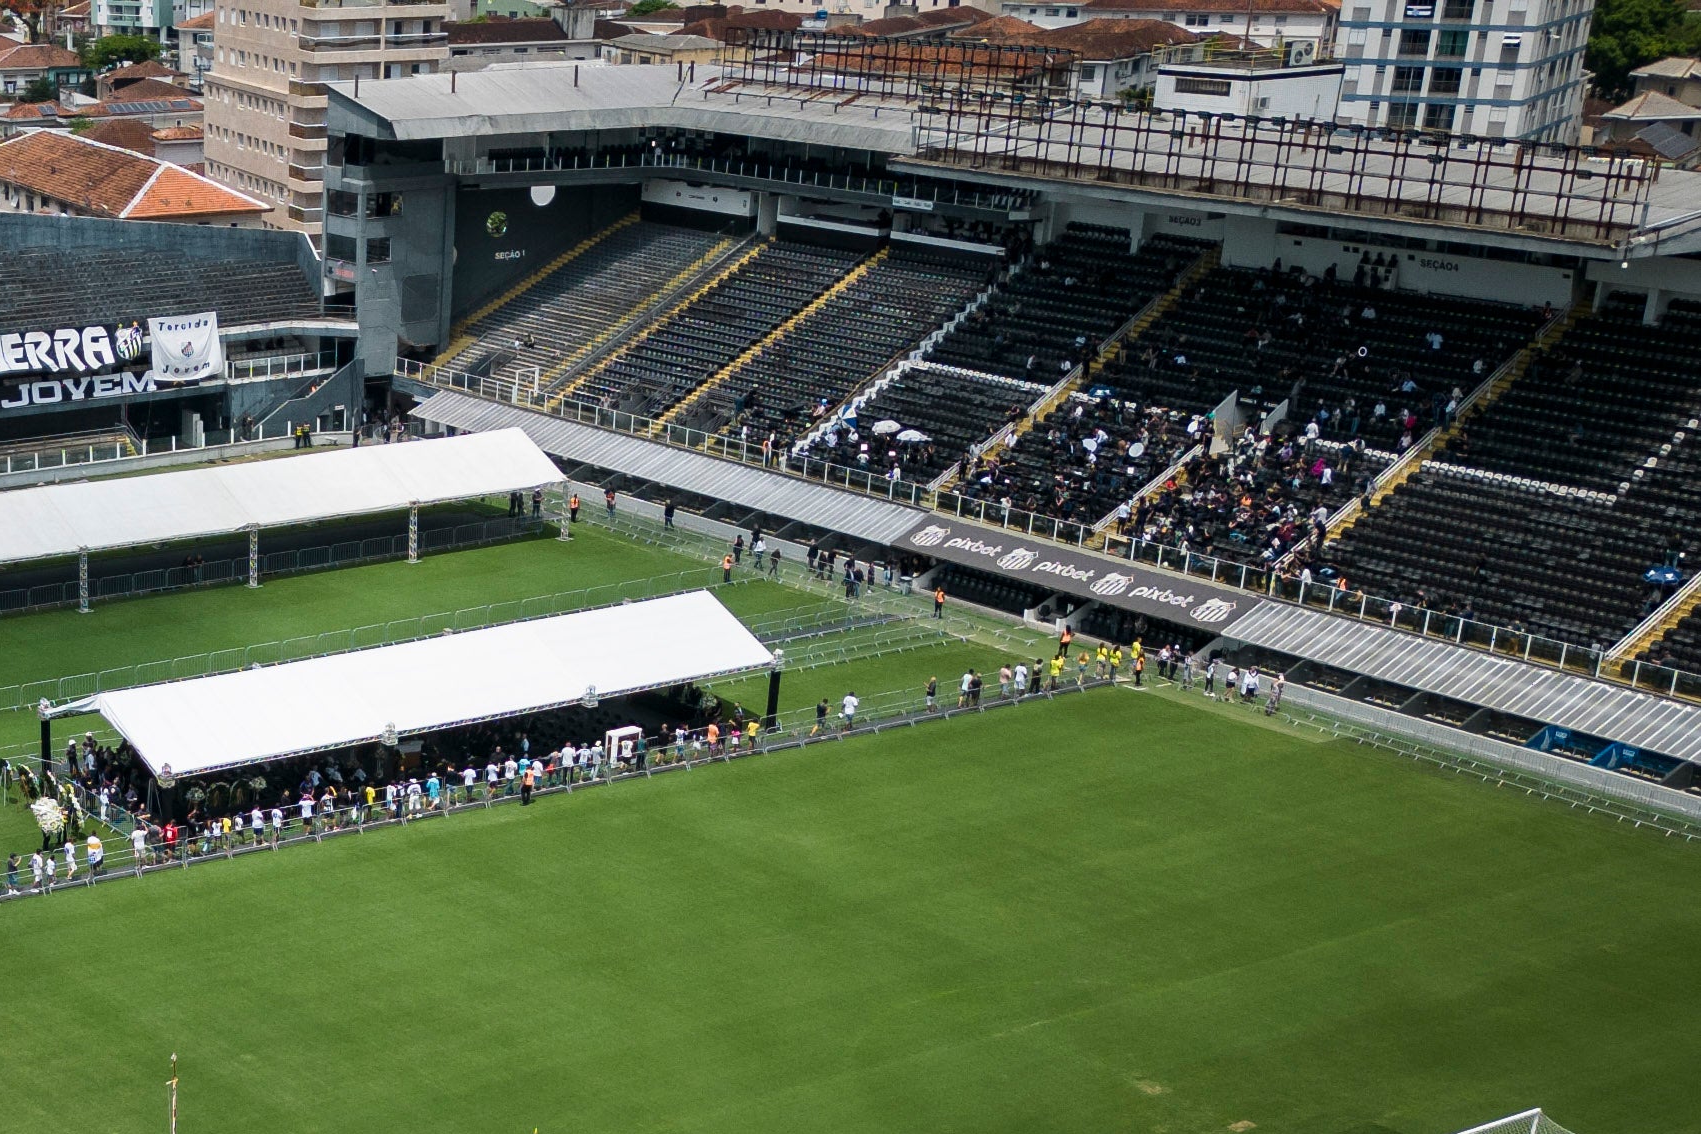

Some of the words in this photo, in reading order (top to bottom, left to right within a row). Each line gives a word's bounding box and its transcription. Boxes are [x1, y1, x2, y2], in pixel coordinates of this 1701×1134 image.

[162, 361, 211, 375] Jovem
[1, 371, 158, 409] JOVEM
[944, 534, 1003, 557] pixbet
[1032, 560, 1095, 583] pixbet
[1128, 585, 1196, 609] pixbet
